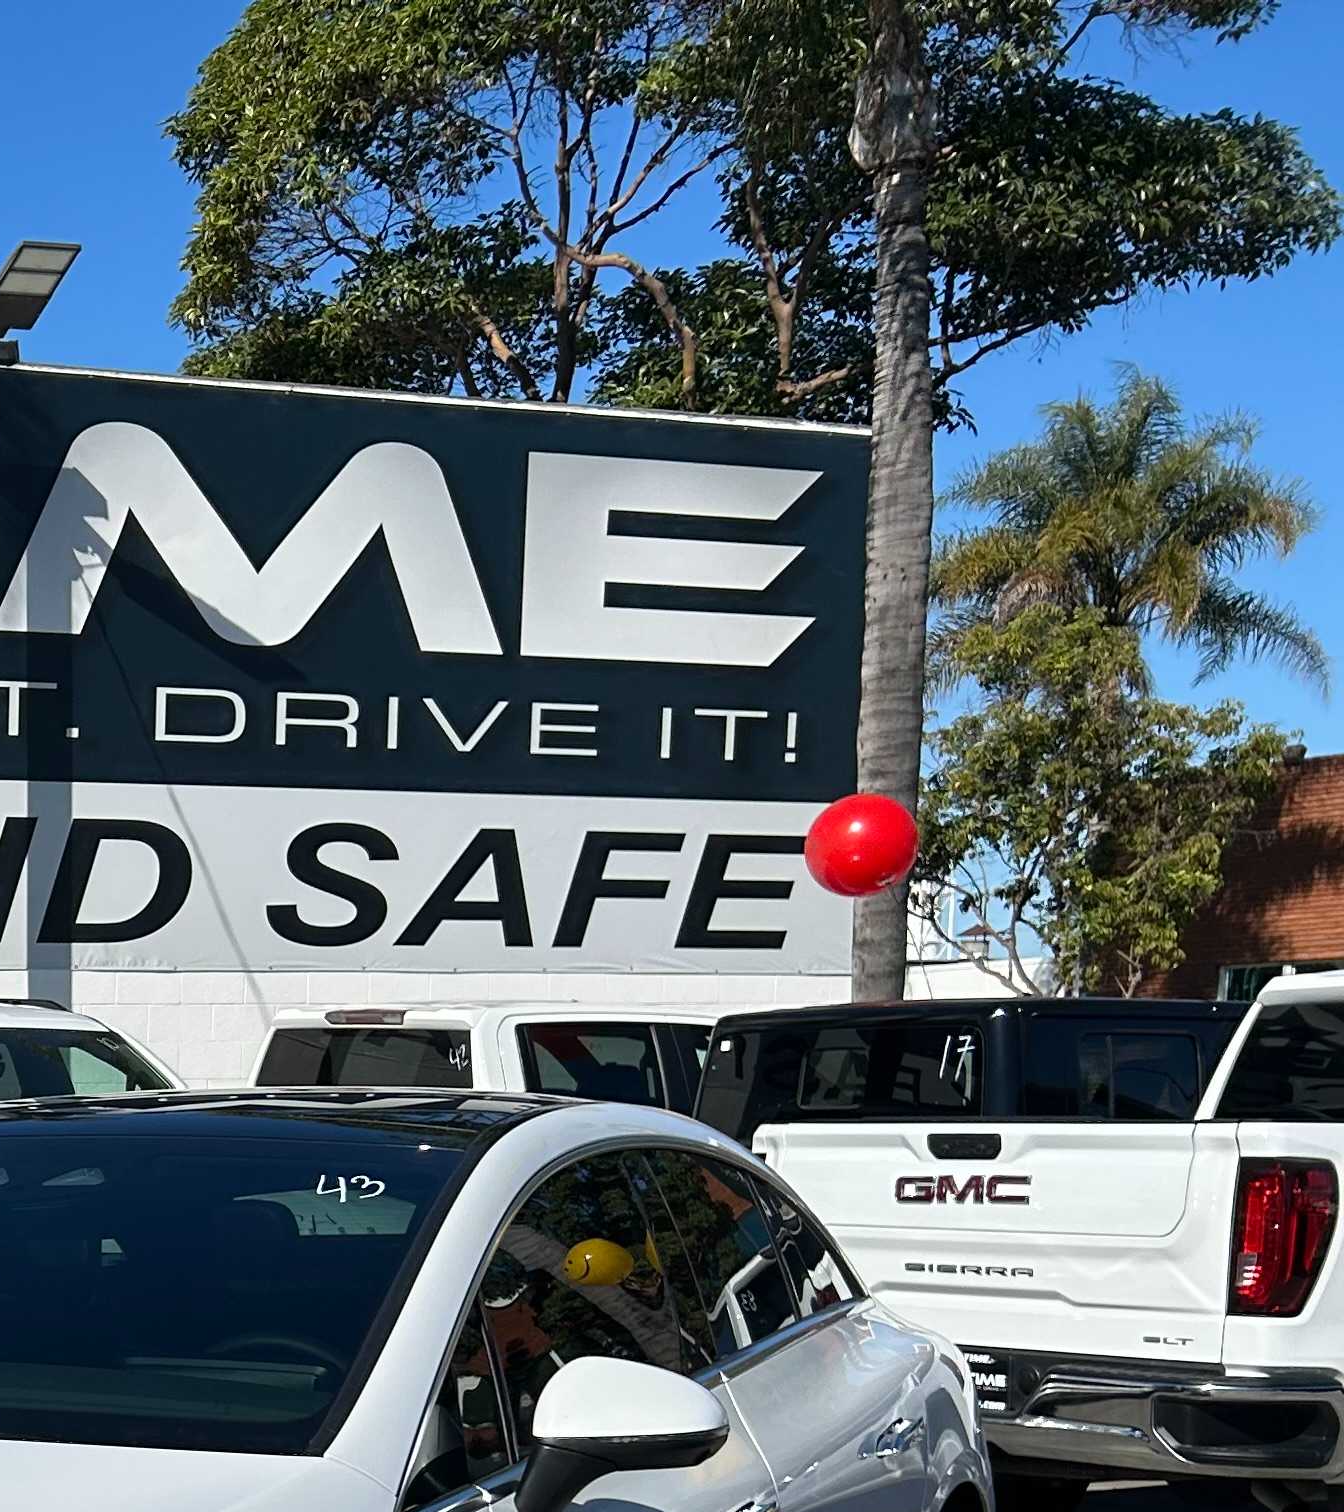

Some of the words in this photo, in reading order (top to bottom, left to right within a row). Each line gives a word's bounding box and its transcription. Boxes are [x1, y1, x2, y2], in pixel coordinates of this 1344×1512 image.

[155, 686, 600, 758] DRIVE
[660, 706, 799, 764] IT!
[266, 822, 807, 950] SAFE
[939, 1034, 975, 1082] 17
[316, 1174, 385, 1203] 43
[895, 1174, 1033, 1204] GMC
[904, 1262, 1034, 1276] SIERRA
[1143, 1336, 1194, 1346] SLT
